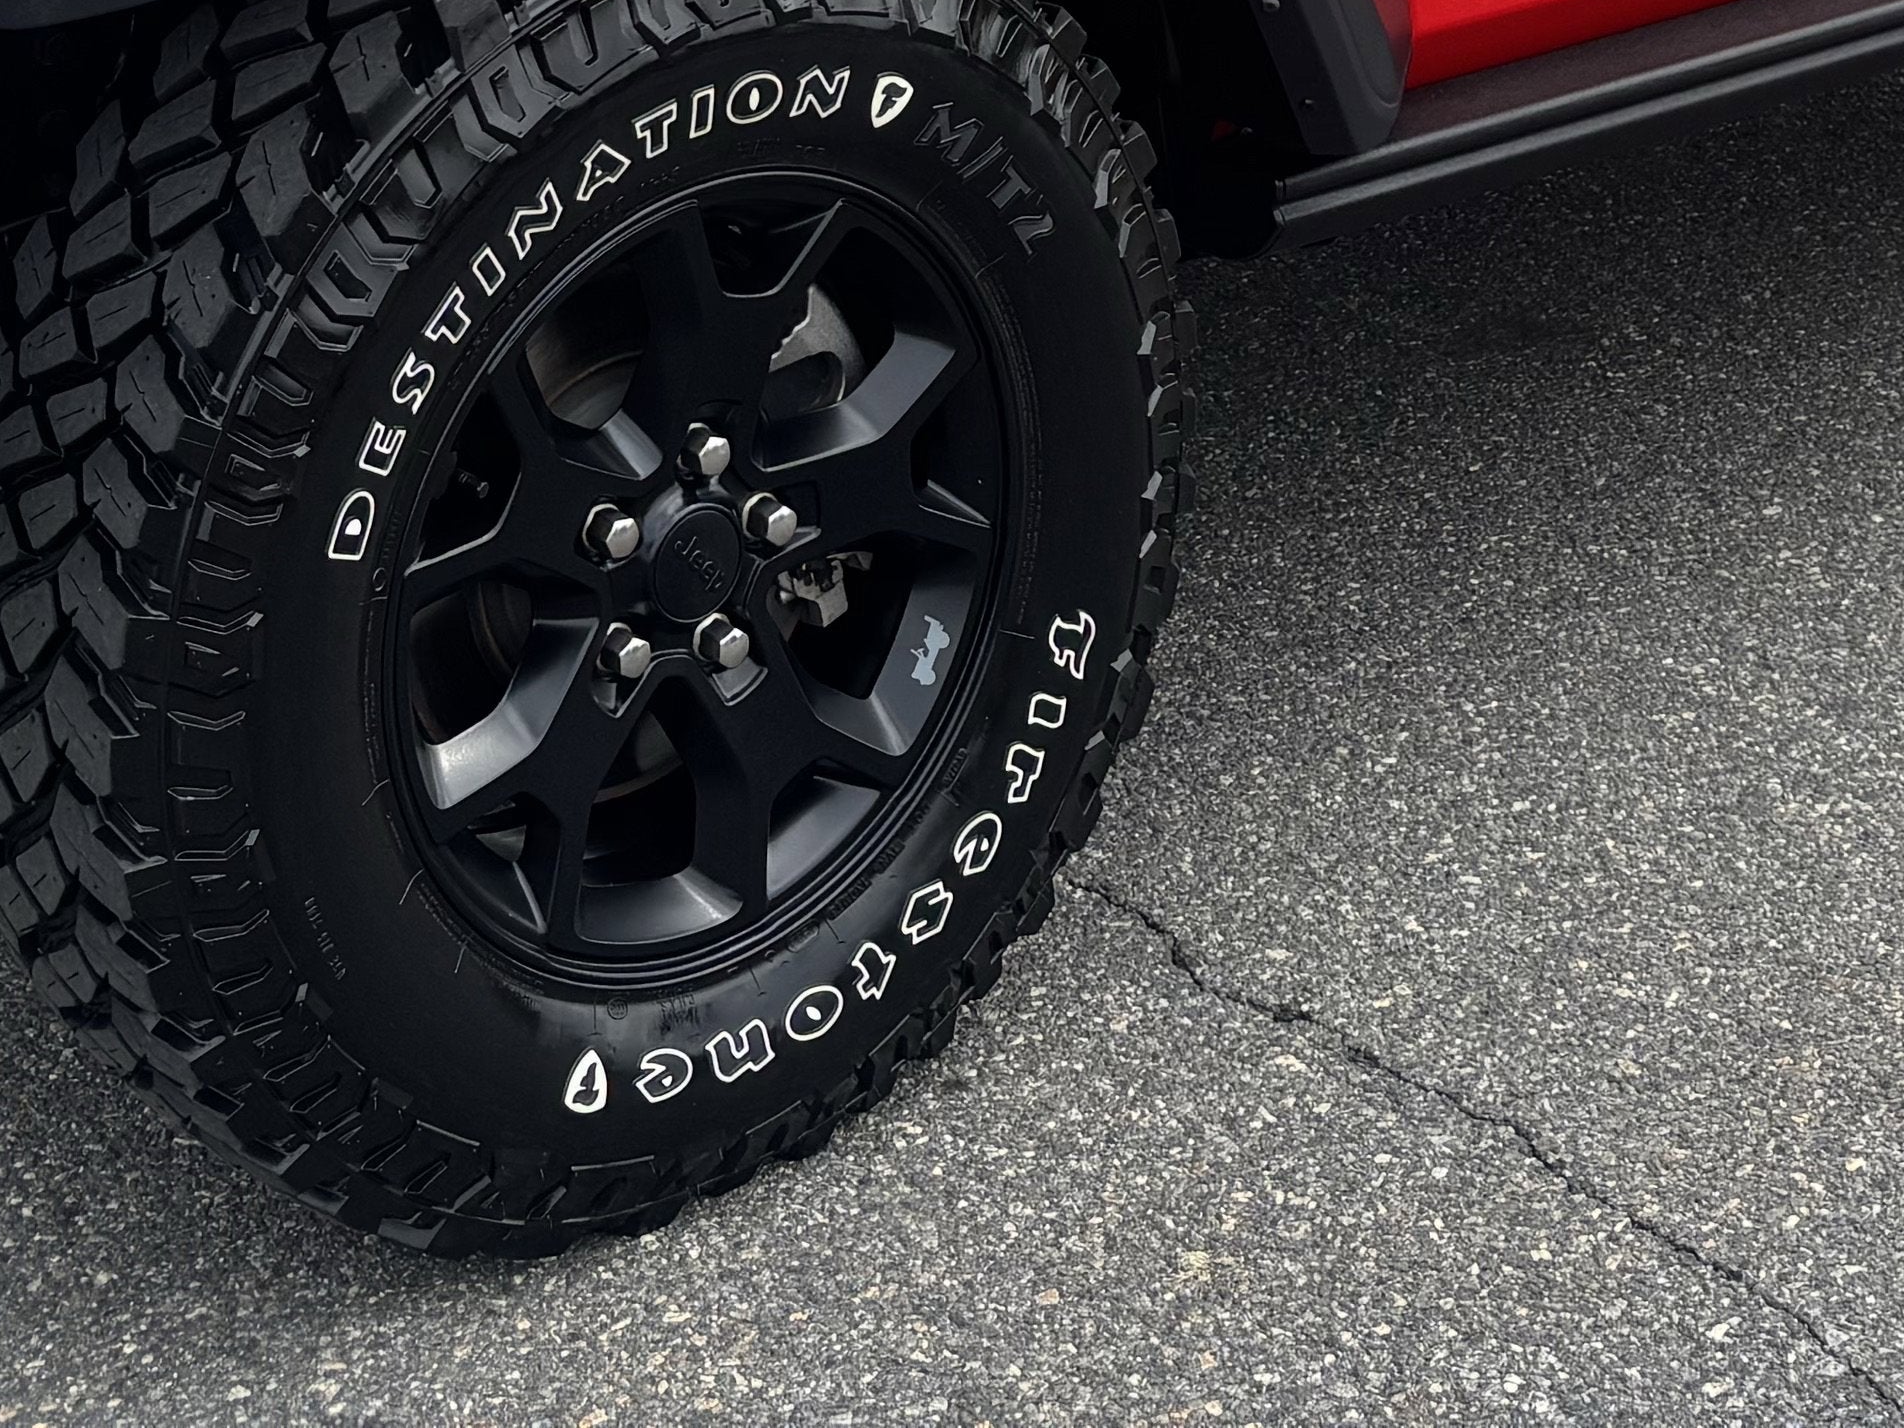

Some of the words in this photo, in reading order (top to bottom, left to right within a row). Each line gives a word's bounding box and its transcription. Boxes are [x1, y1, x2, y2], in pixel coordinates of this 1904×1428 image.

[327, 66, 850, 561] DESTINATION
[674, 535, 725, 592] Jeep
[633, 608, 1096, 1103] Firestone
